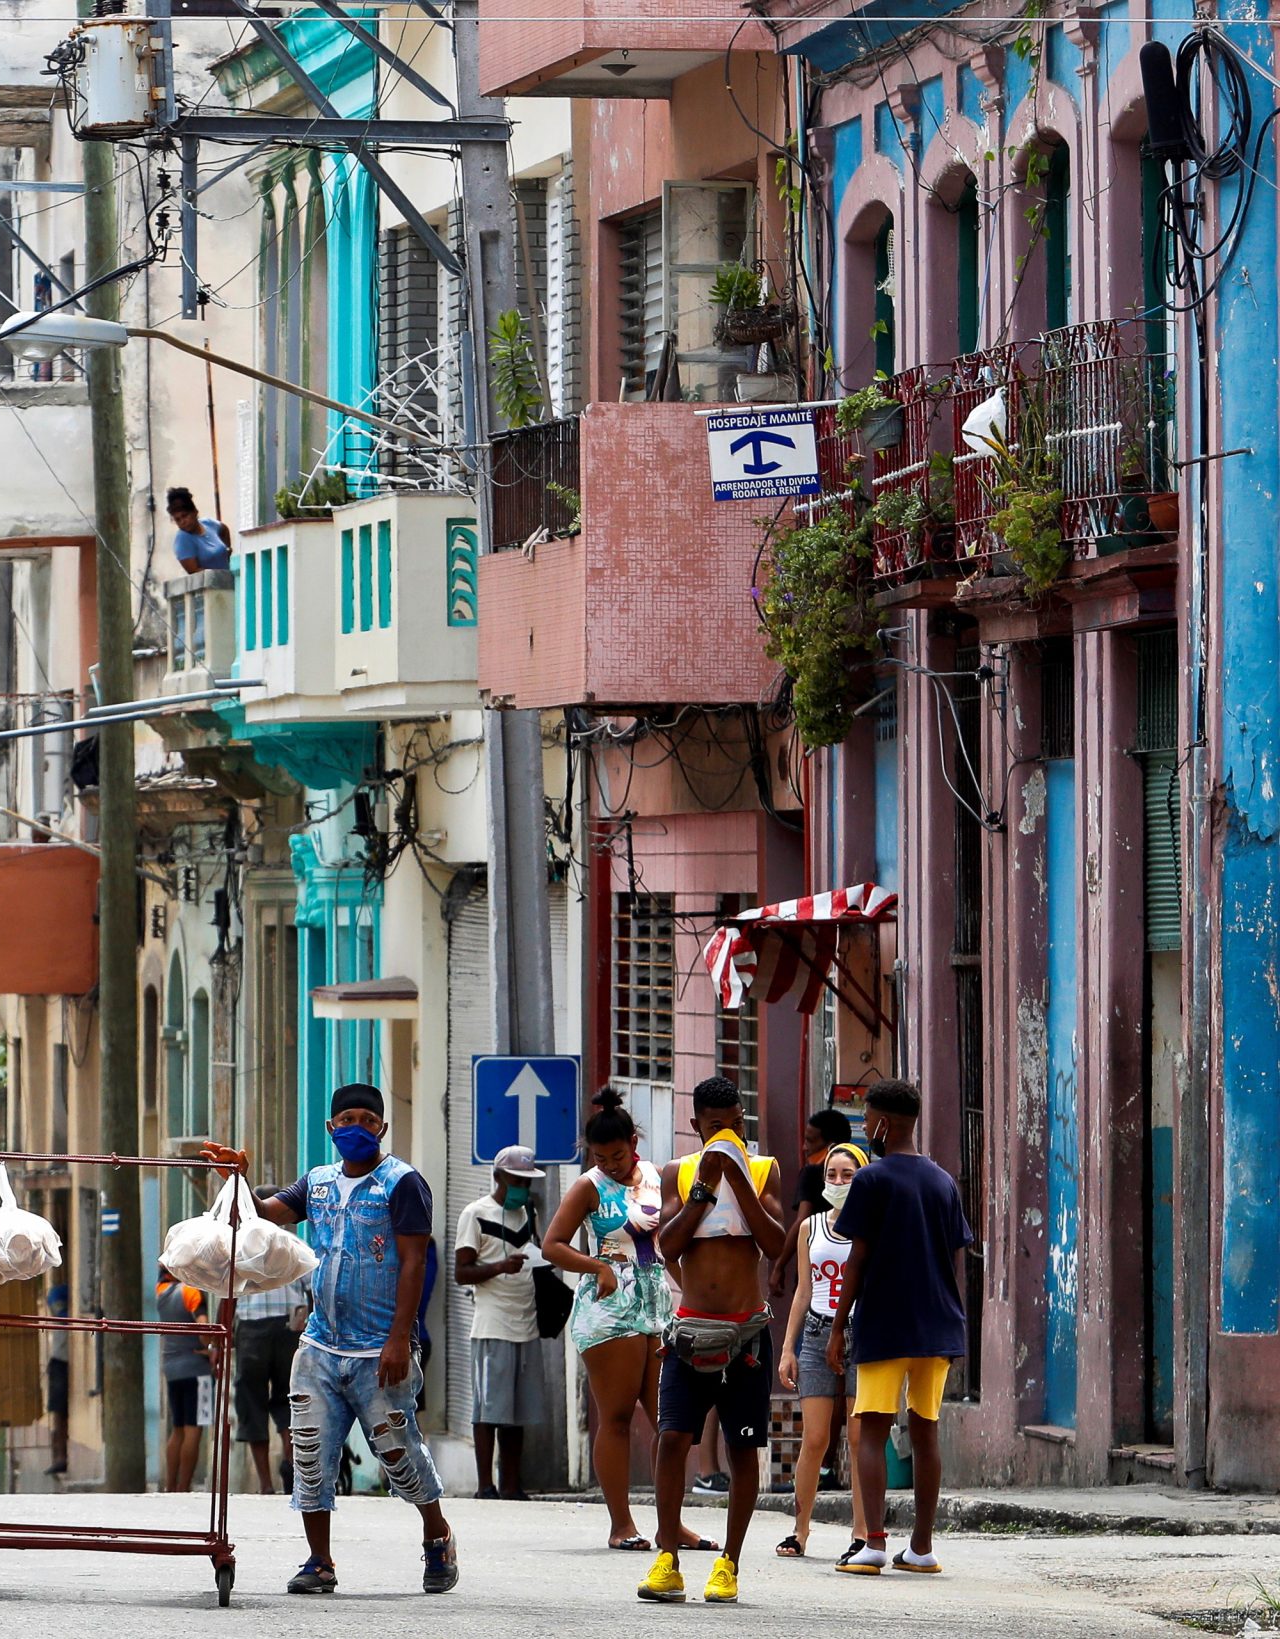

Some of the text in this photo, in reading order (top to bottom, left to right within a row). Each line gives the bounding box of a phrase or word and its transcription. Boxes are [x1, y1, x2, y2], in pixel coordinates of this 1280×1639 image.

[709, 409, 813, 429] HOSPEDAJE MAMITÉ
[714, 476, 817, 492] ARRENDADOR EN DIVISA
[732, 486, 801, 499] ROOM FOR RENT
